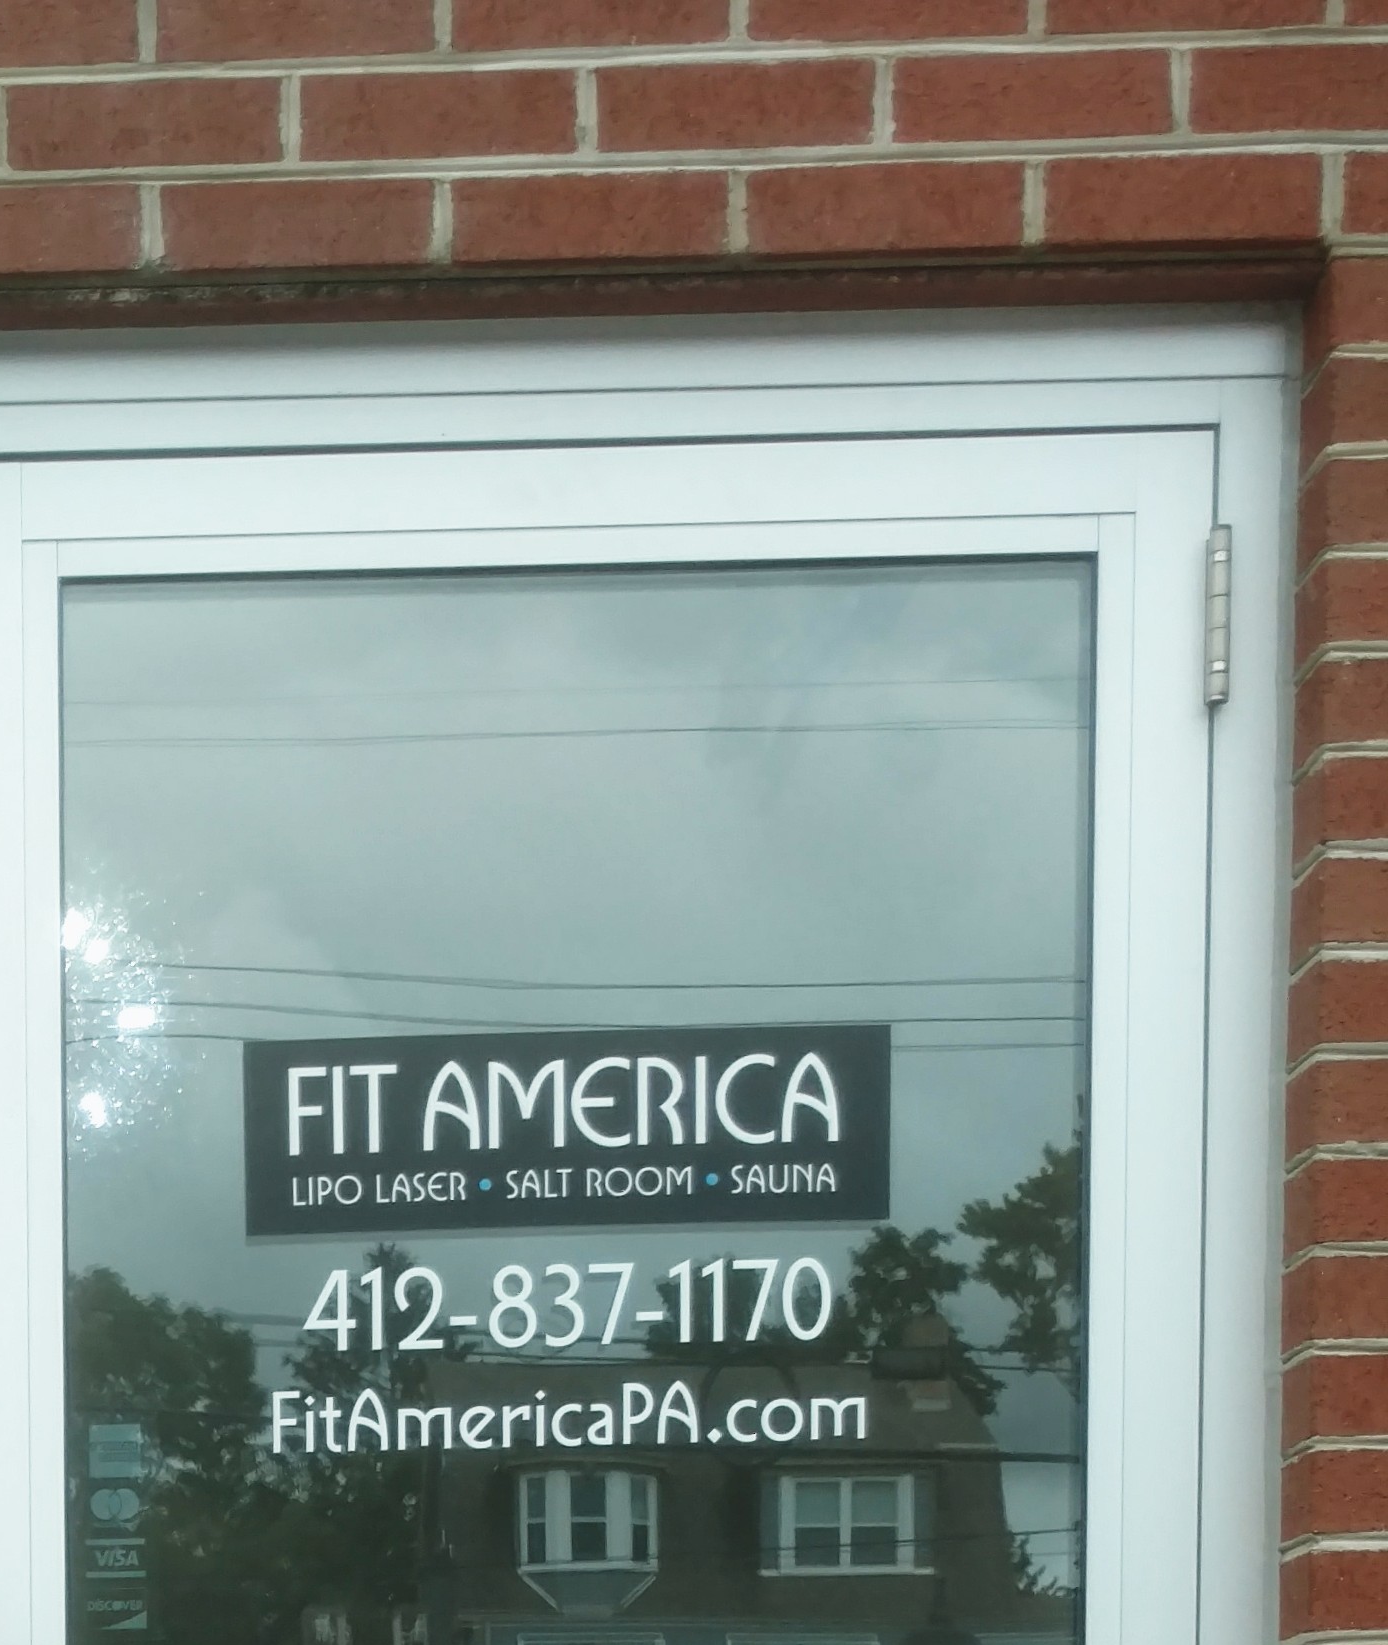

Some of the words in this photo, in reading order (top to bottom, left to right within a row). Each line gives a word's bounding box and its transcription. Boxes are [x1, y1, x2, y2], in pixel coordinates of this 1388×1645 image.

[288, 1064, 398, 1156] FIT
[423, 1052, 839, 1151] AMERICA
[292, 1175, 362, 1206] LIPO
[376, 1172, 466, 1203] LASER
[506, 1168, 572, 1199] SALT
[586, 1166, 692, 1197] ROOM
[731, 1163, 836, 1194] SAUNA
[302, 1256, 832, 1352] 412-837-1170
[272, 1380, 866, 1454] FitAmericaPA.com
[94, 1549, 140, 1567] VISA
